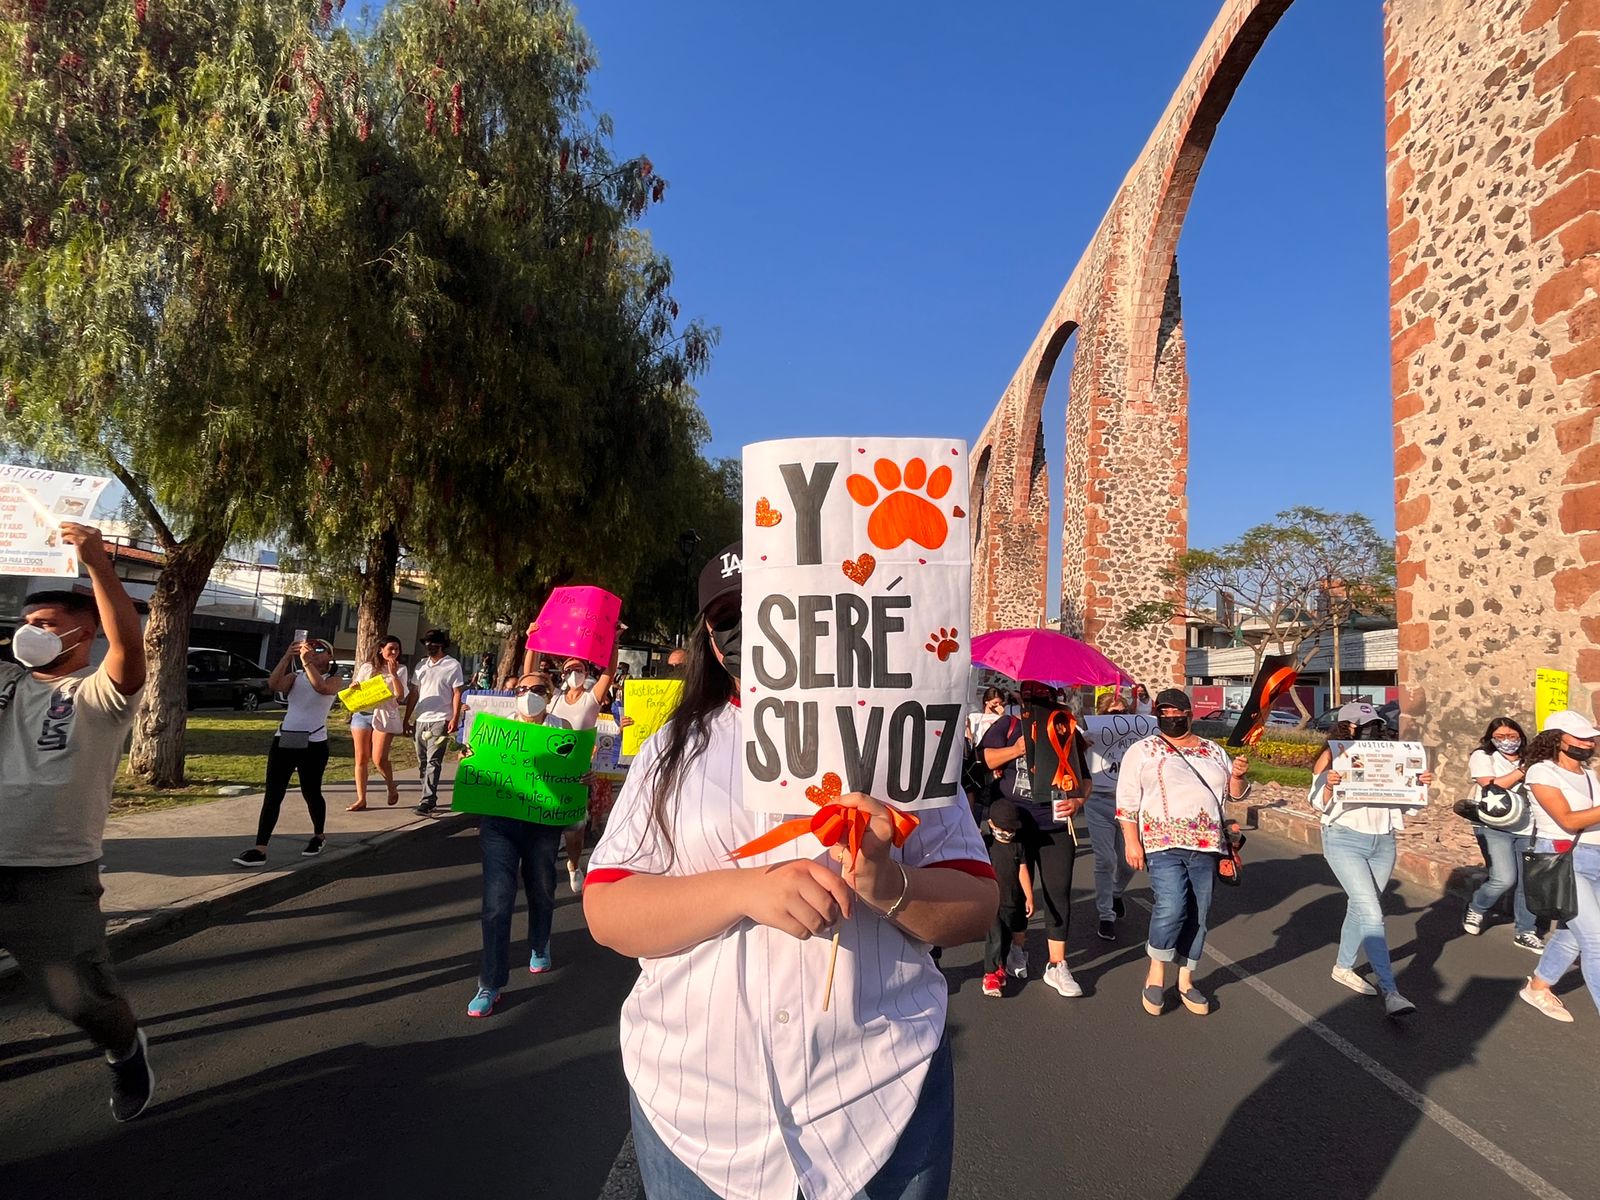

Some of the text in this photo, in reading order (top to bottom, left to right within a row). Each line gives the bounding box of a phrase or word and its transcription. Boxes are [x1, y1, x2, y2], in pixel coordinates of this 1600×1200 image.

[779, 462, 839, 565] Y
[720, 552, 743, 579] LA
[752, 576, 912, 691] SERÉ
[470, 721, 529, 753] ANIMAL
[746, 696, 819, 783] SU
[835, 700, 962, 804] VOZ
[1357, 741, 1395, 750] JUSTICIA
[460, 764, 515, 789] BESTIA
[496, 788, 512, 800] es
[516, 789, 553, 806] quien
